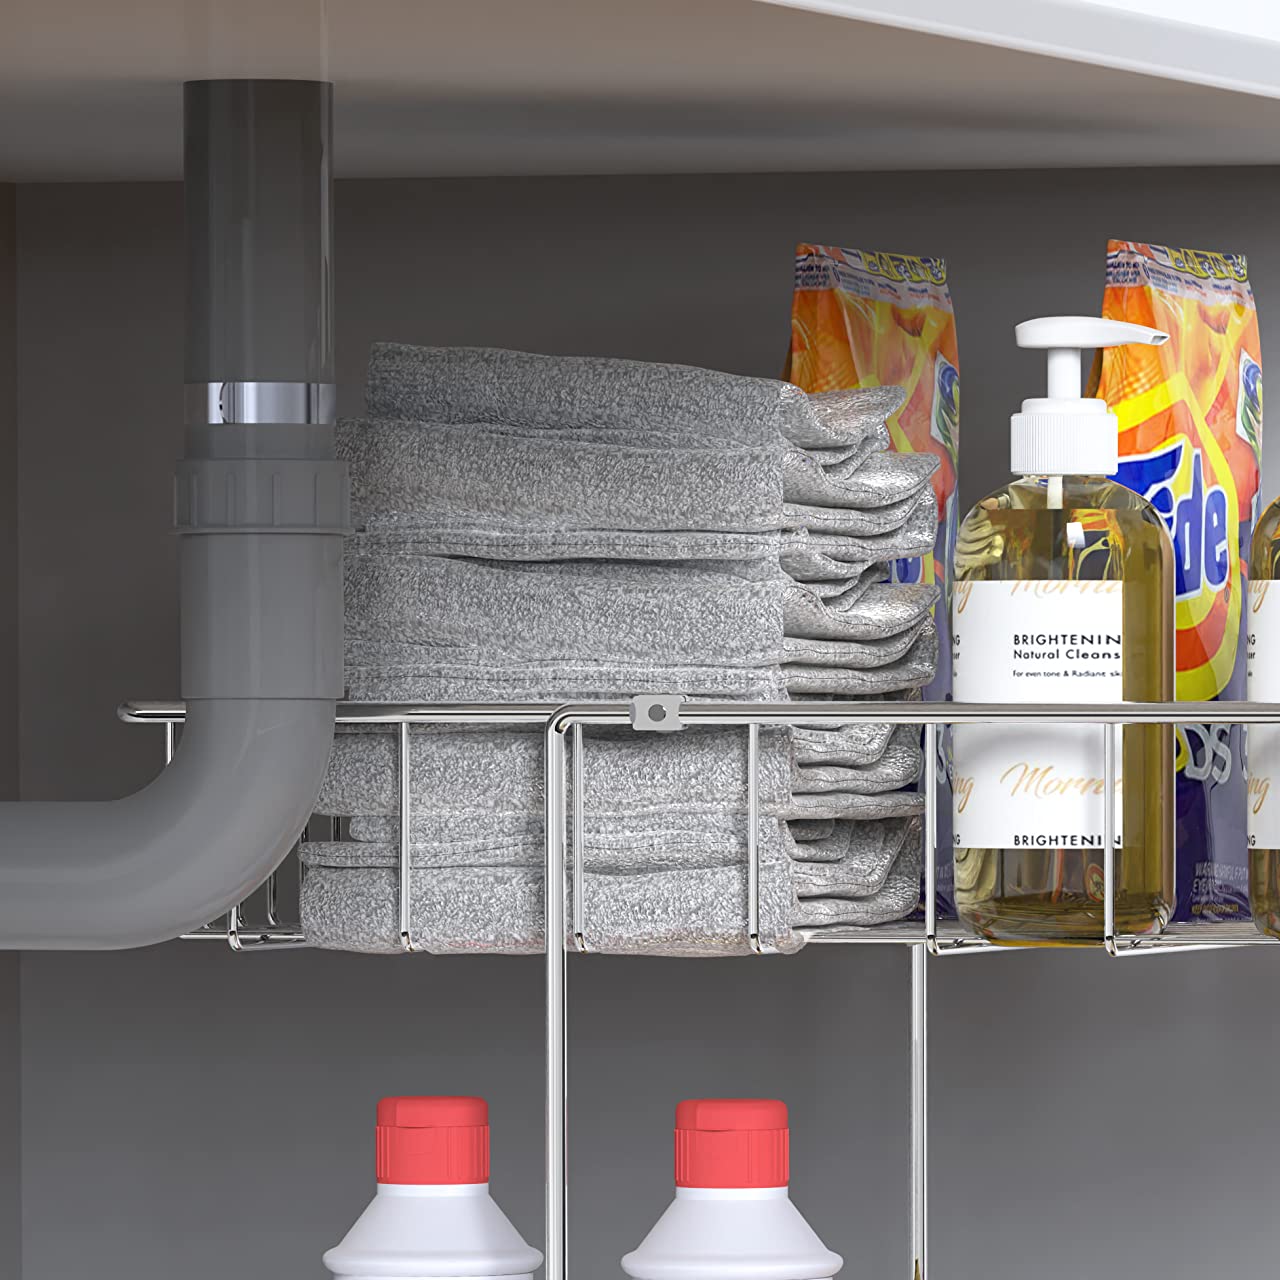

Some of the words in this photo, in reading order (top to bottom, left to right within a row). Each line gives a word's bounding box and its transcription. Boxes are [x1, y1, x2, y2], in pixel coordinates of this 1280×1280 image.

[1013, 634, 1121, 646] BRIGHTENIN
[1013, 649, 1060, 660] Natural
[1065, 649, 1121, 660] Cleans
[1013, 835, 1121, 846] BRIGHTENIN
